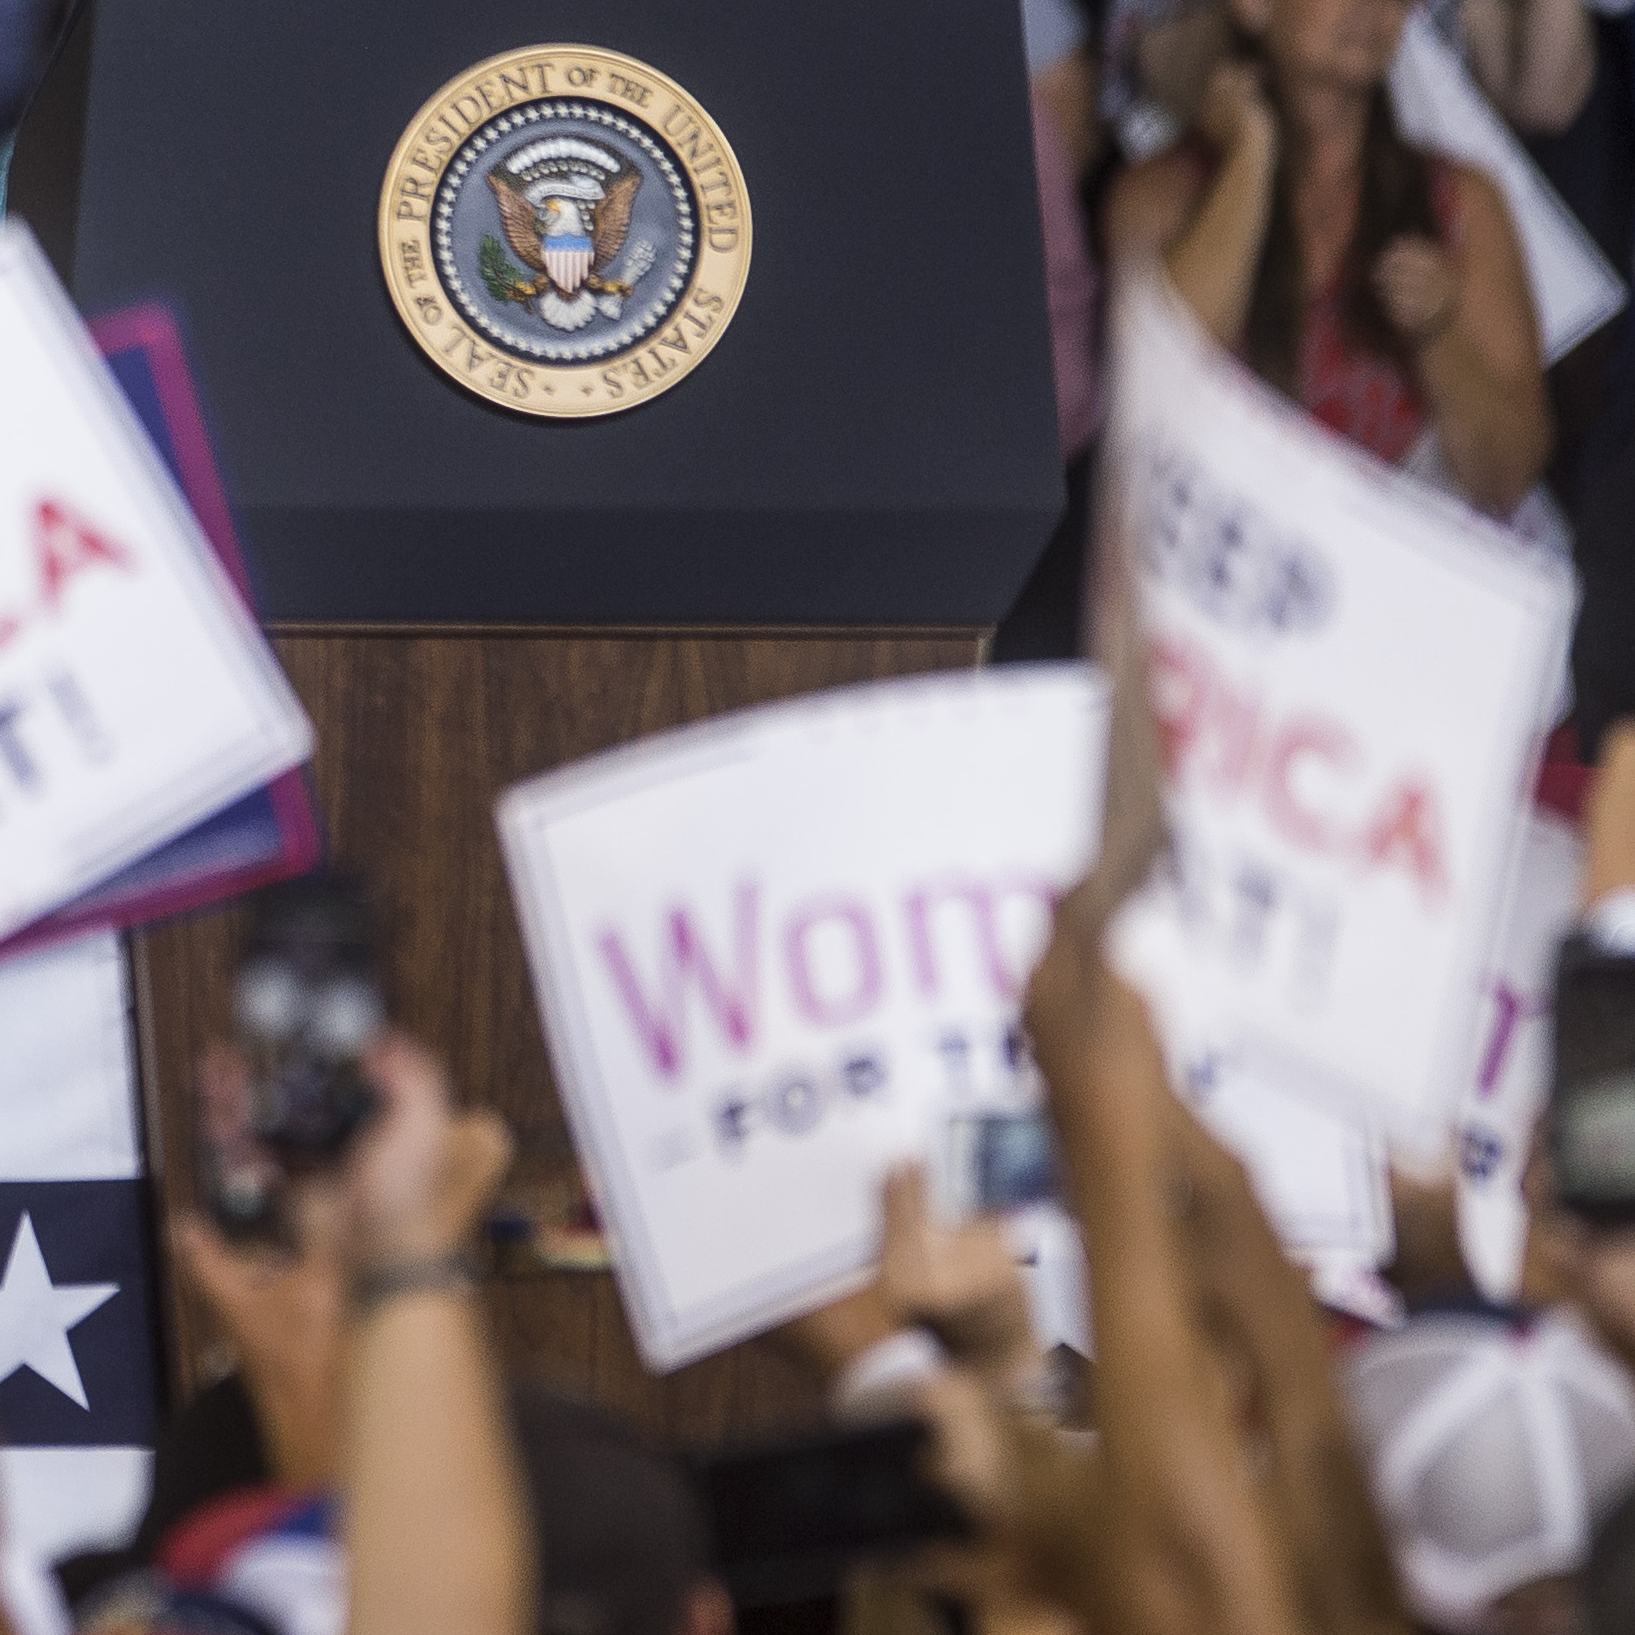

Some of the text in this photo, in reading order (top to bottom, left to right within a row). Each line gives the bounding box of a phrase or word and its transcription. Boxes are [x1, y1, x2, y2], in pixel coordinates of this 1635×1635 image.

[397, 61, 555, 223] PRESIDENT
[607, 72, 655, 109] THE
[659, 104, 740, 255] UNITED
[400, 238, 430, 283] THE
[442, 323, 537, 400] SEAL
[601, 286, 726, 400] STATES
[1147, 637, 1456, 922] RICA
[595, 872, 1061, 1090] Wom
[709, 1036, 894, 1166] FOR
